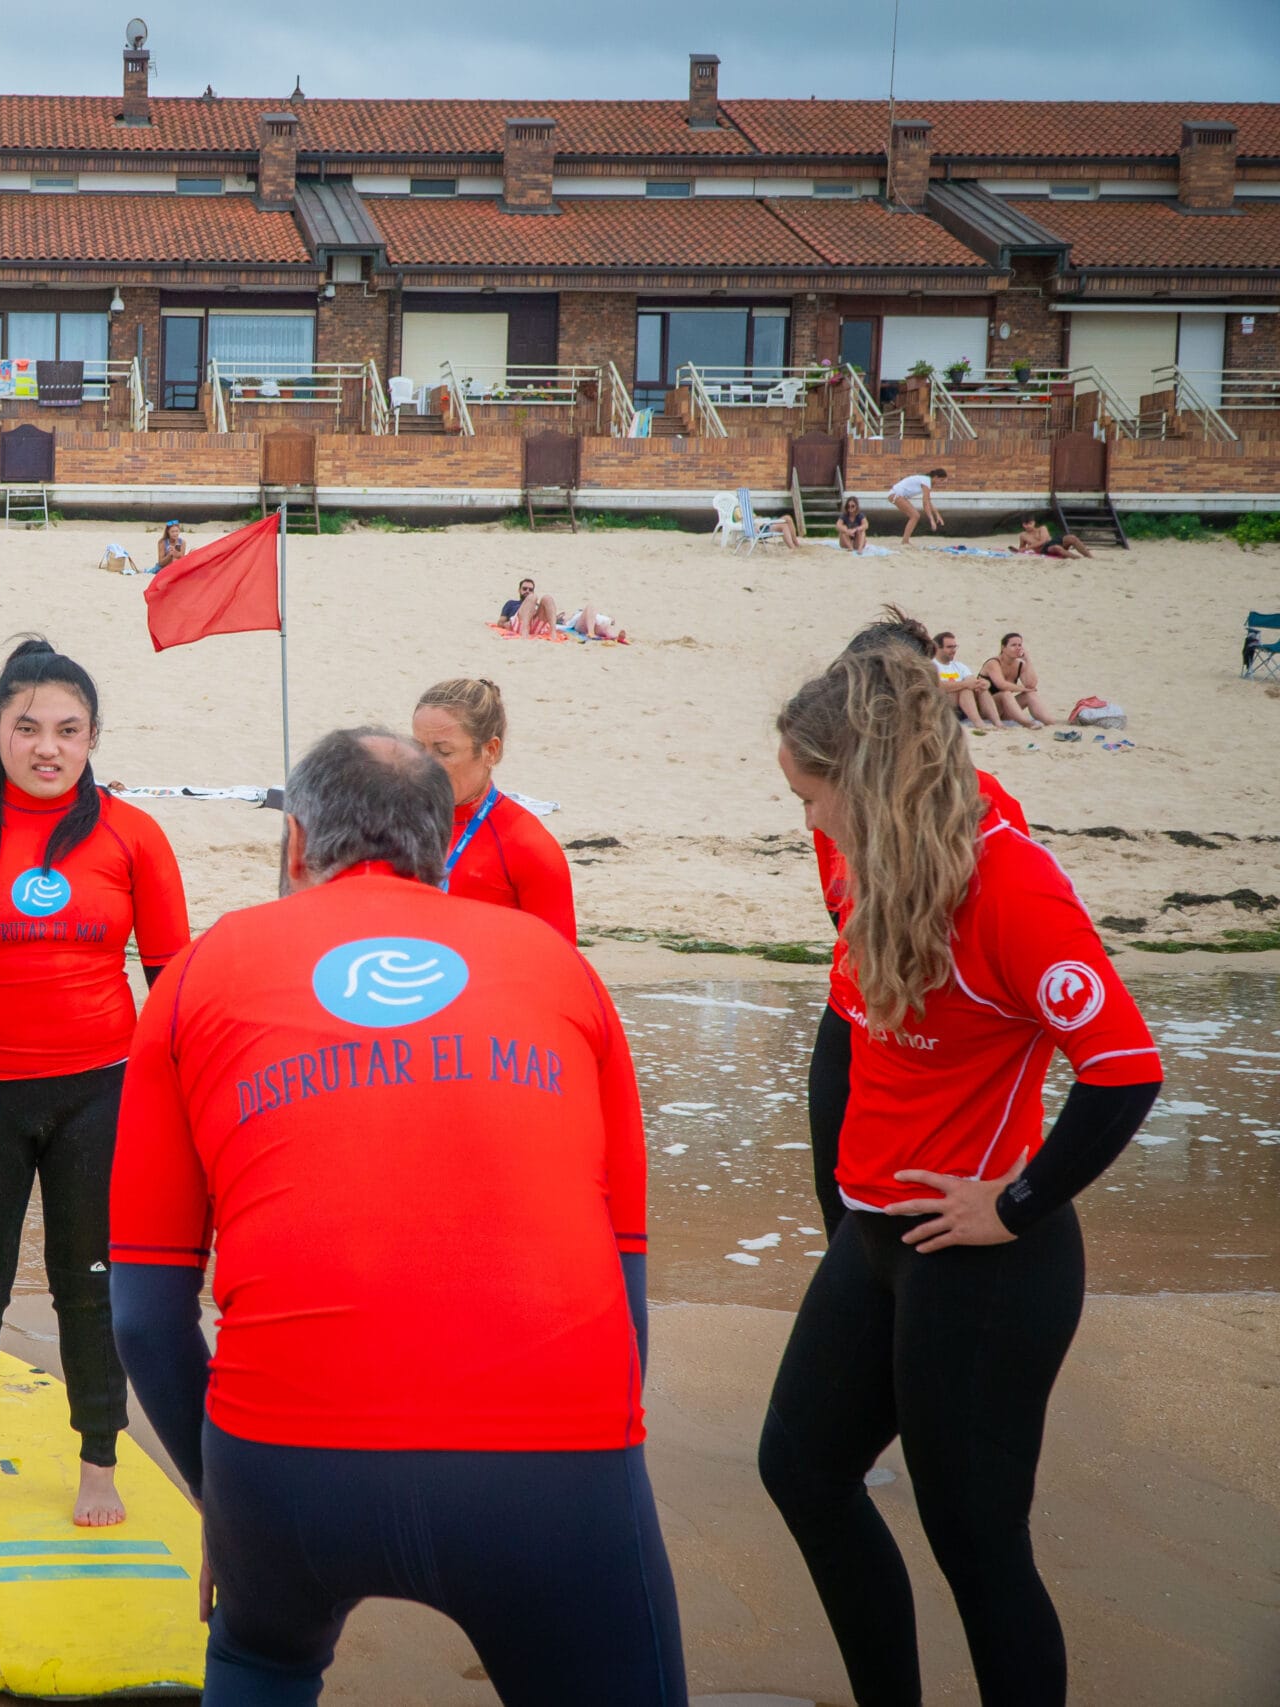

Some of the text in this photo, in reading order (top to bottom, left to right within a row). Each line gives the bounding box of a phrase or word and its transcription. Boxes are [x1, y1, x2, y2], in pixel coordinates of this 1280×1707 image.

[74, 922, 107, 943] MAR
[236, 1034, 563, 1125] DISFRUTAR EL MAR
